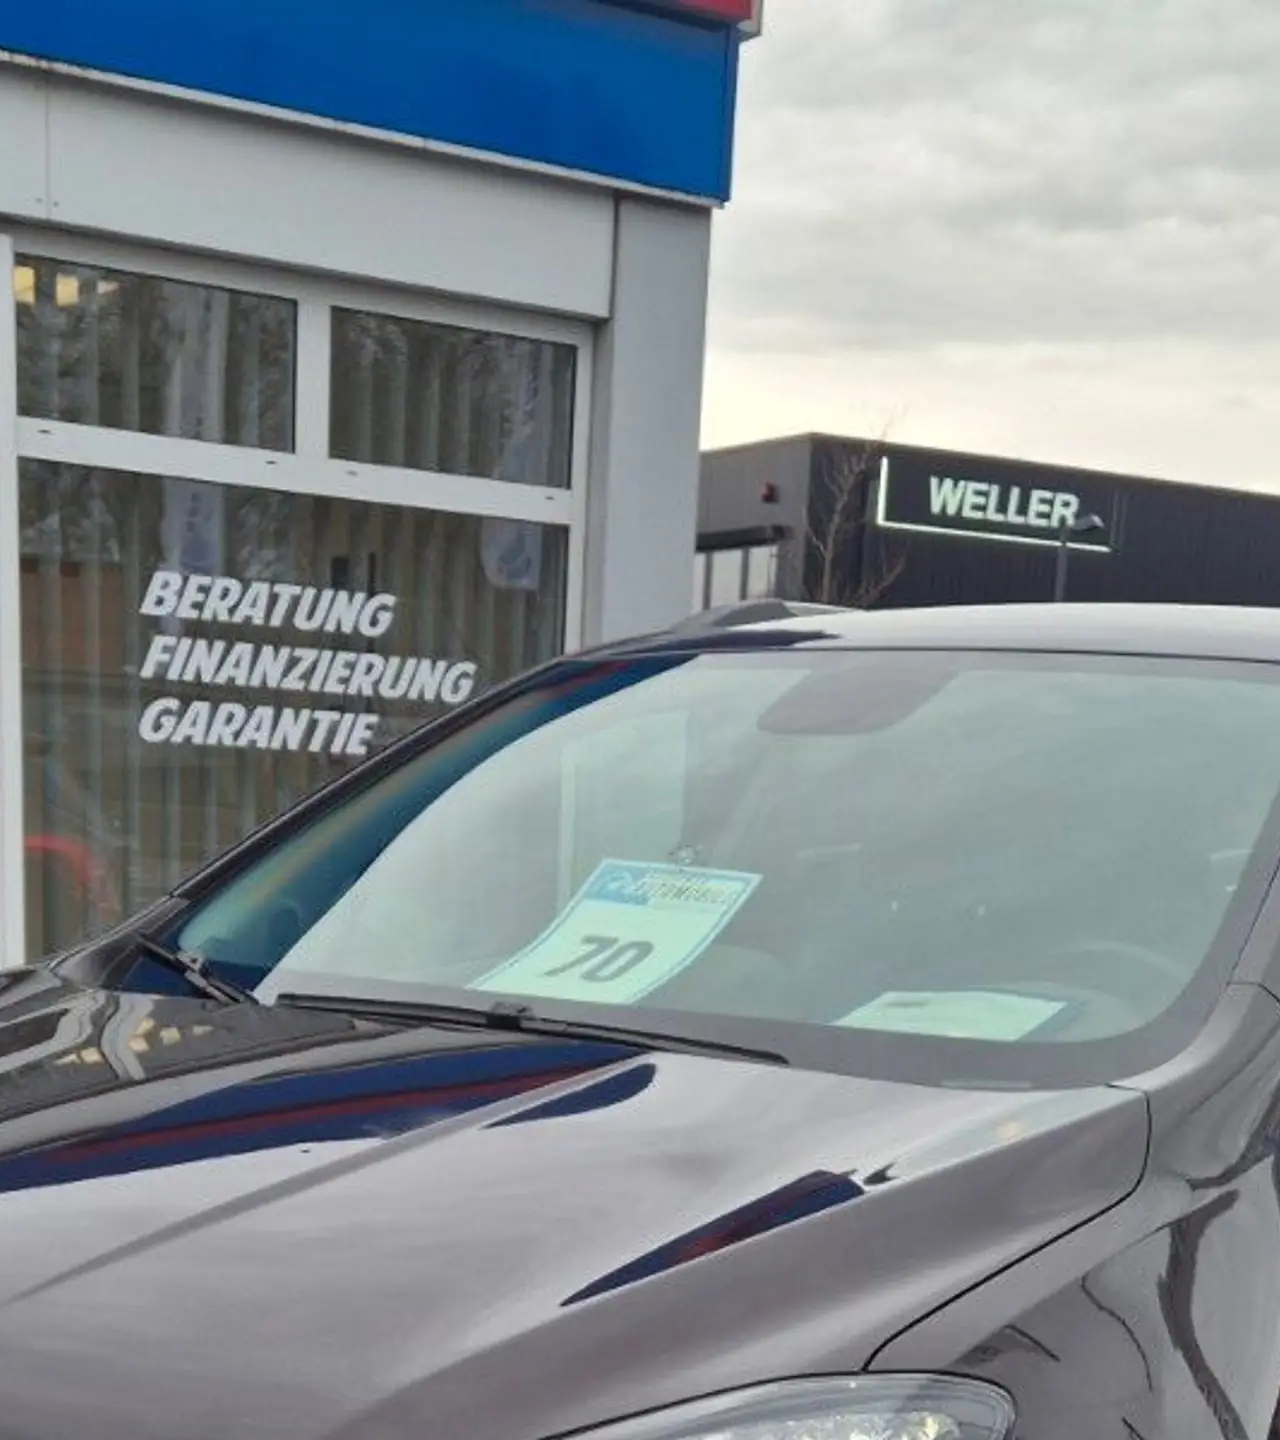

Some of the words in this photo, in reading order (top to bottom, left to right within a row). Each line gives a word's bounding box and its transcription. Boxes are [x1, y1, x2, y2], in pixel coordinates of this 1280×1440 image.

[929, 475, 1081, 528] WELLER
[139, 570, 397, 637] BERATUNG
[139, 635, 478, 704] FINANZIERUNG
[138, 697, 381, 756] GARANTIE
[544, 934, 655, 983] 70
